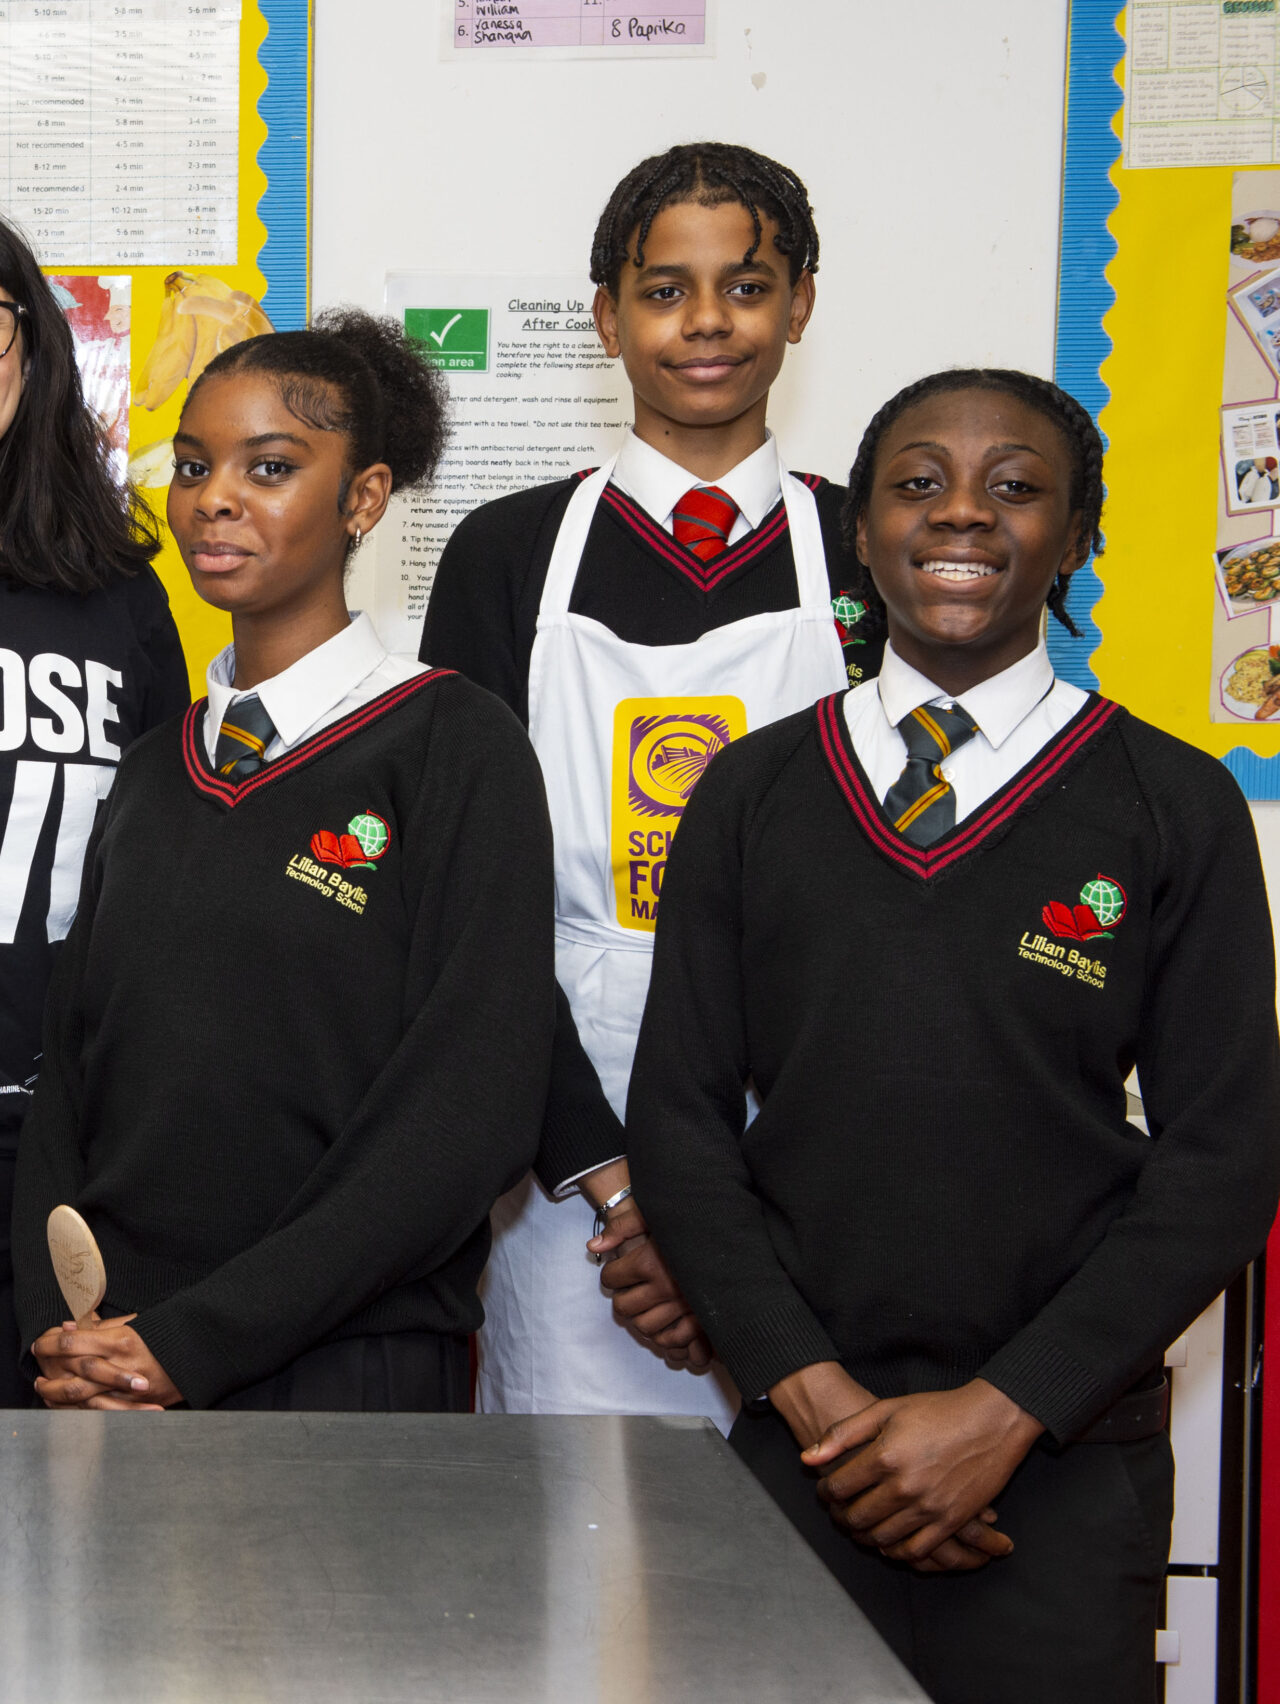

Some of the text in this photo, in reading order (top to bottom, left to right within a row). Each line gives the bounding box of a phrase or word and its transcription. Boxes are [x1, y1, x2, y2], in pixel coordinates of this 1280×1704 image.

[34, 8, 50, 16] 5-10
[202, 6, 216, 14] min
[476, 4, 520, 16] William
[457, 26, 469, 37] 6.
[611, 18, 686, 41] 8 Paprika
[130, 118, 144, 126] min
[508, 299, 584, 313] Cleaning Up
[522, 318, 596, 330] After Cook
[543, 342, 560, 350] right
[449, 359, 474, 367] area
[543, 362, 573, 370] following
[583, 397, 618, 405] equipment
[527, 445, 560, 454] detergent
[288, 854, 369, 906] Lilian Baylis
[284, 866, 365, 915] Technology School
[1019, 931, 1107, 979] Lilian Baylis
[1017, 947, 1105, 990] Technology School
